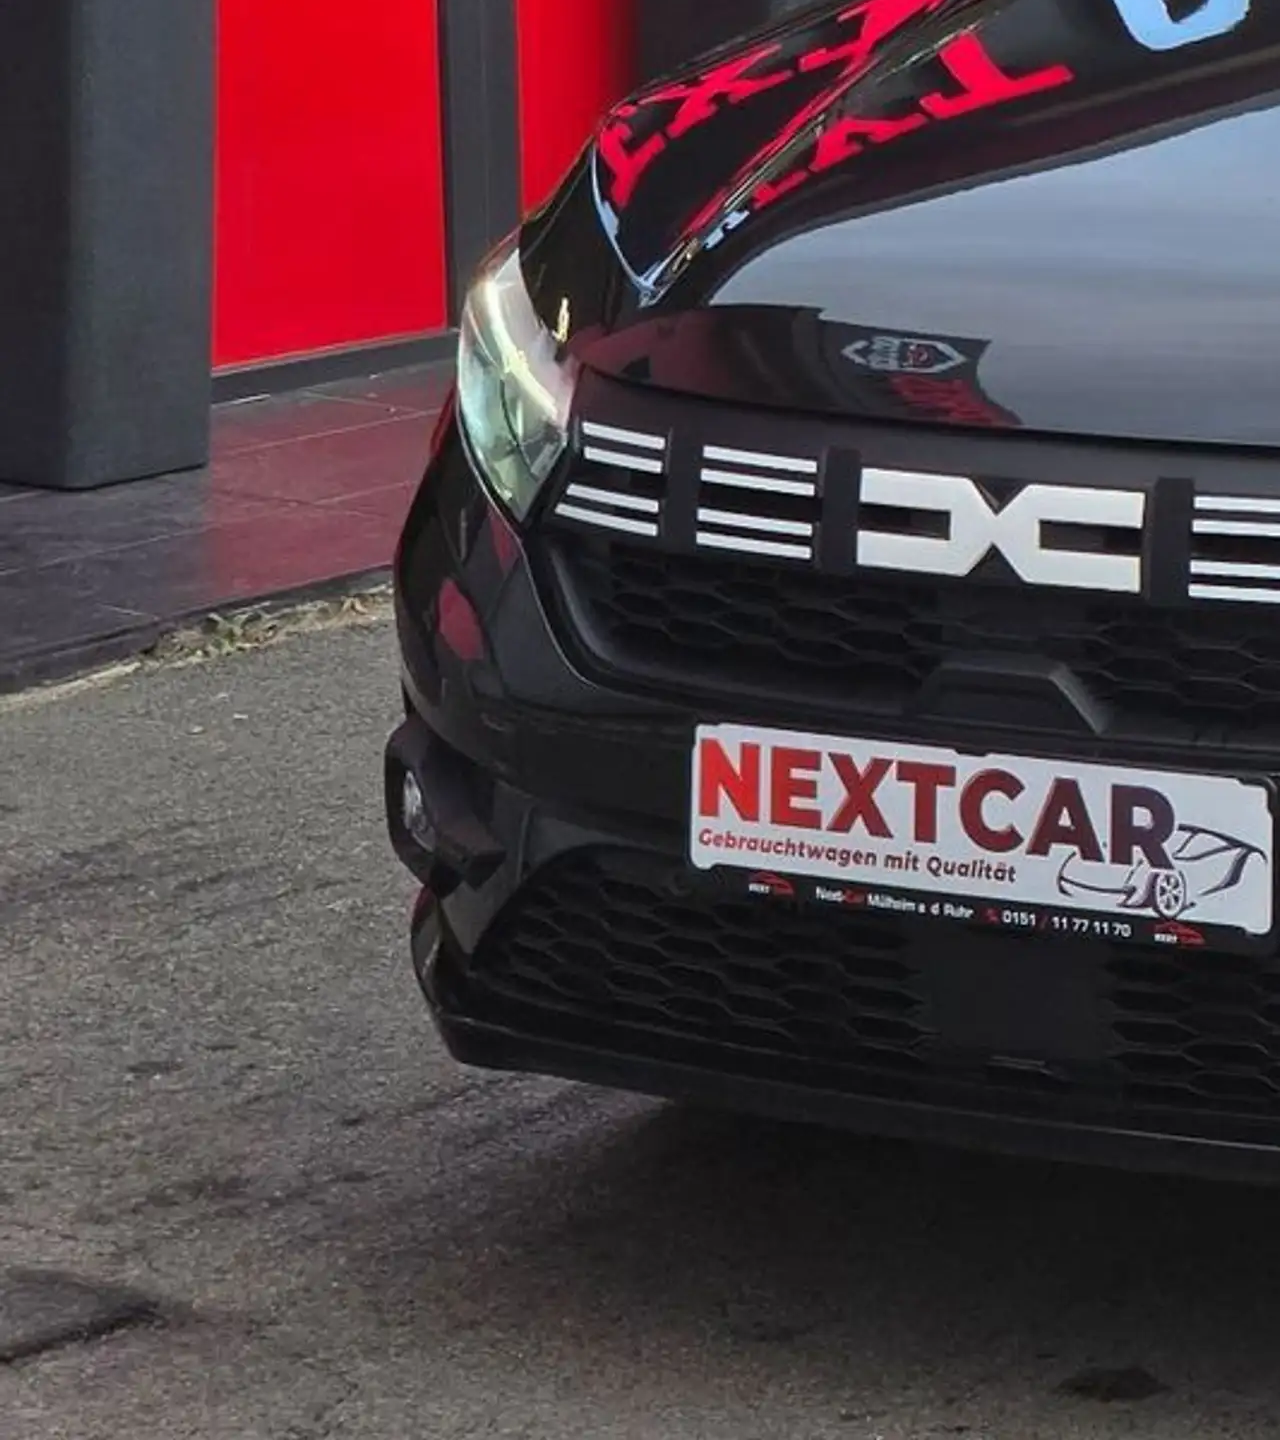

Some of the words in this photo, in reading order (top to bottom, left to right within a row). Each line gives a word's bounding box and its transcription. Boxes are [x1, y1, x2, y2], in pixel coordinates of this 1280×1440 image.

[699, 738, 1176, 872] NEXTCAR
[698, 827, 878, 867] Gebrauchtwagen
[883, 850, 920, 871] mit
[926, 855, 1017, 883] Qualität
[1002, 909, 1036, 927] 0151
[1052, 916, 1068, 930] 11
[1072, 918, 1089, 933] 77
[1093, 920, 1109, 935] 11
